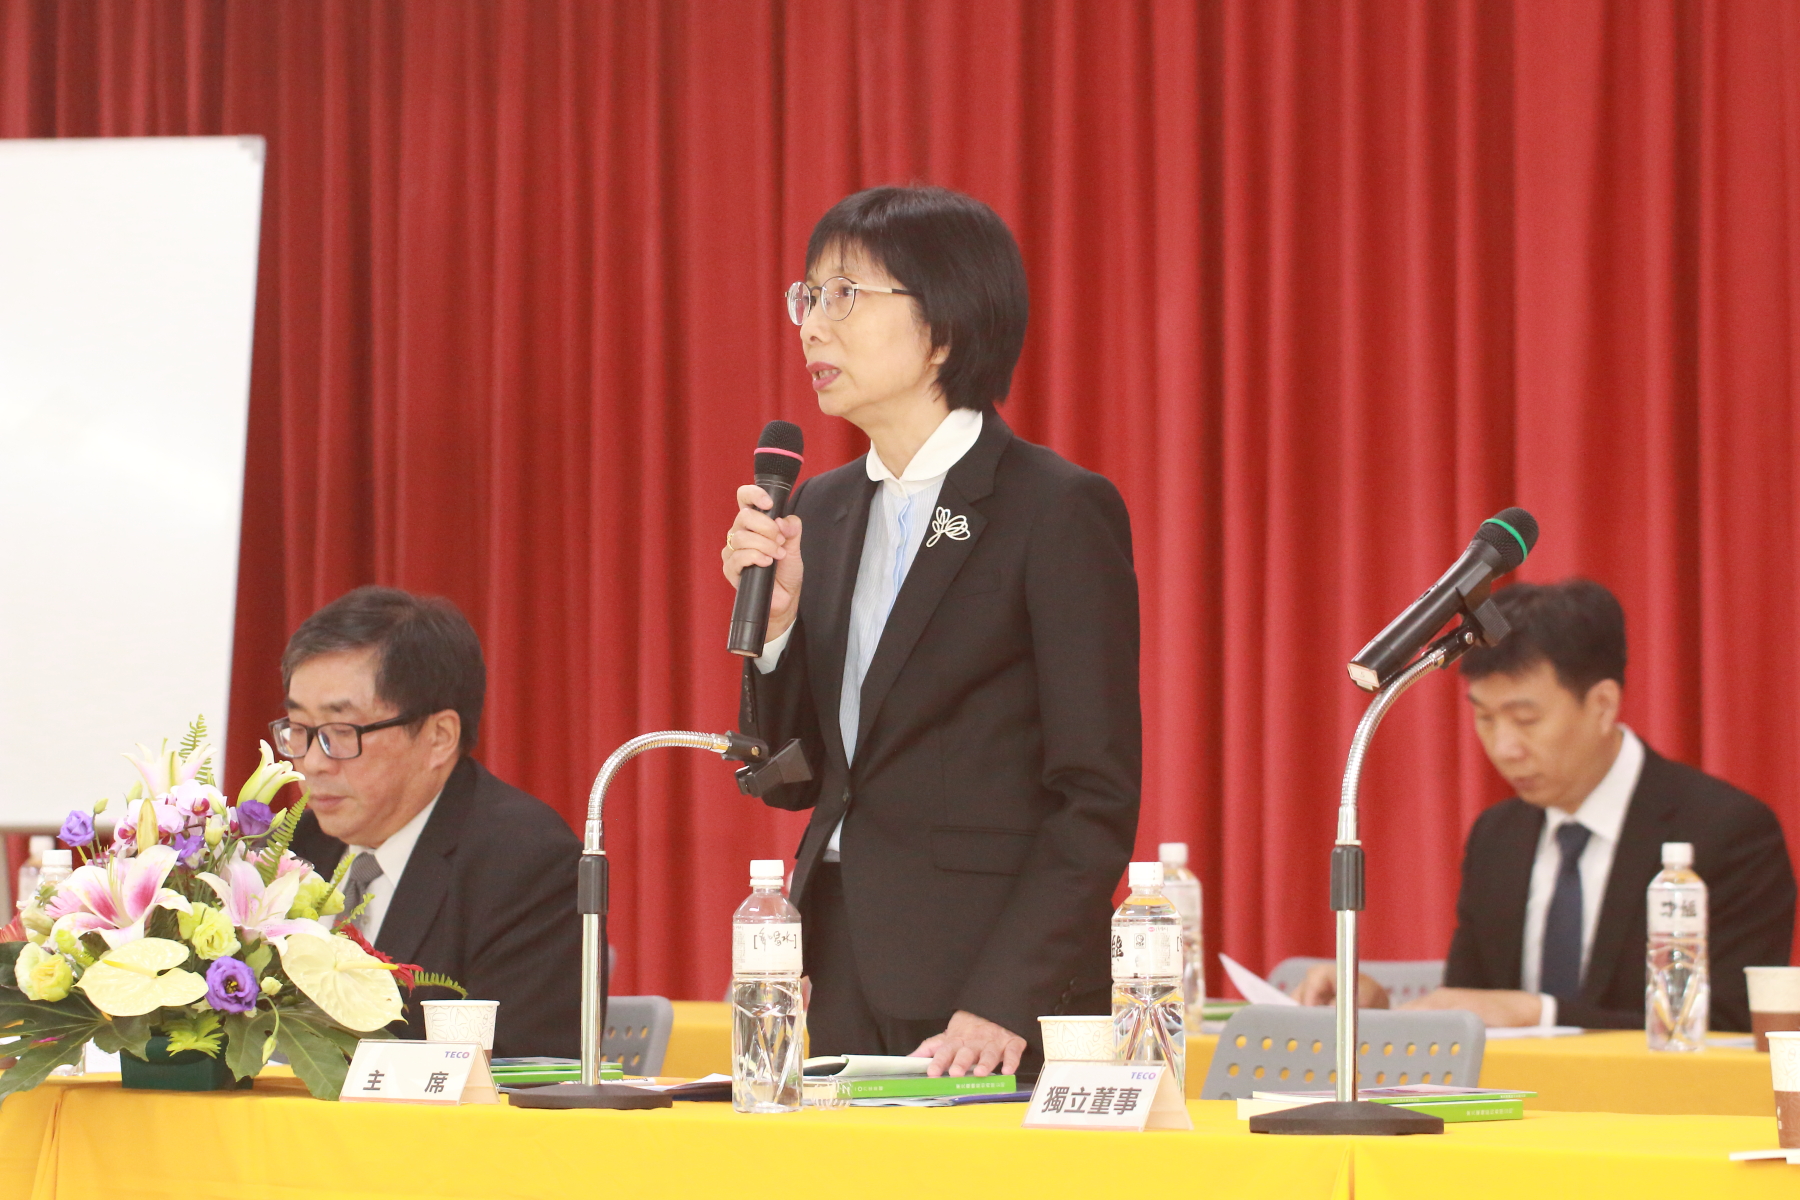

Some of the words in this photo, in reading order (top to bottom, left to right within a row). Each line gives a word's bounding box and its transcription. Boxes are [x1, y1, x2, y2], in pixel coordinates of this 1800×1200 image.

[444, 1051, 470, 1059] TECO
[1131, 1072, 1156, 1080] TECO
[1041, 1086, 1142, 1115] 獨立董事
